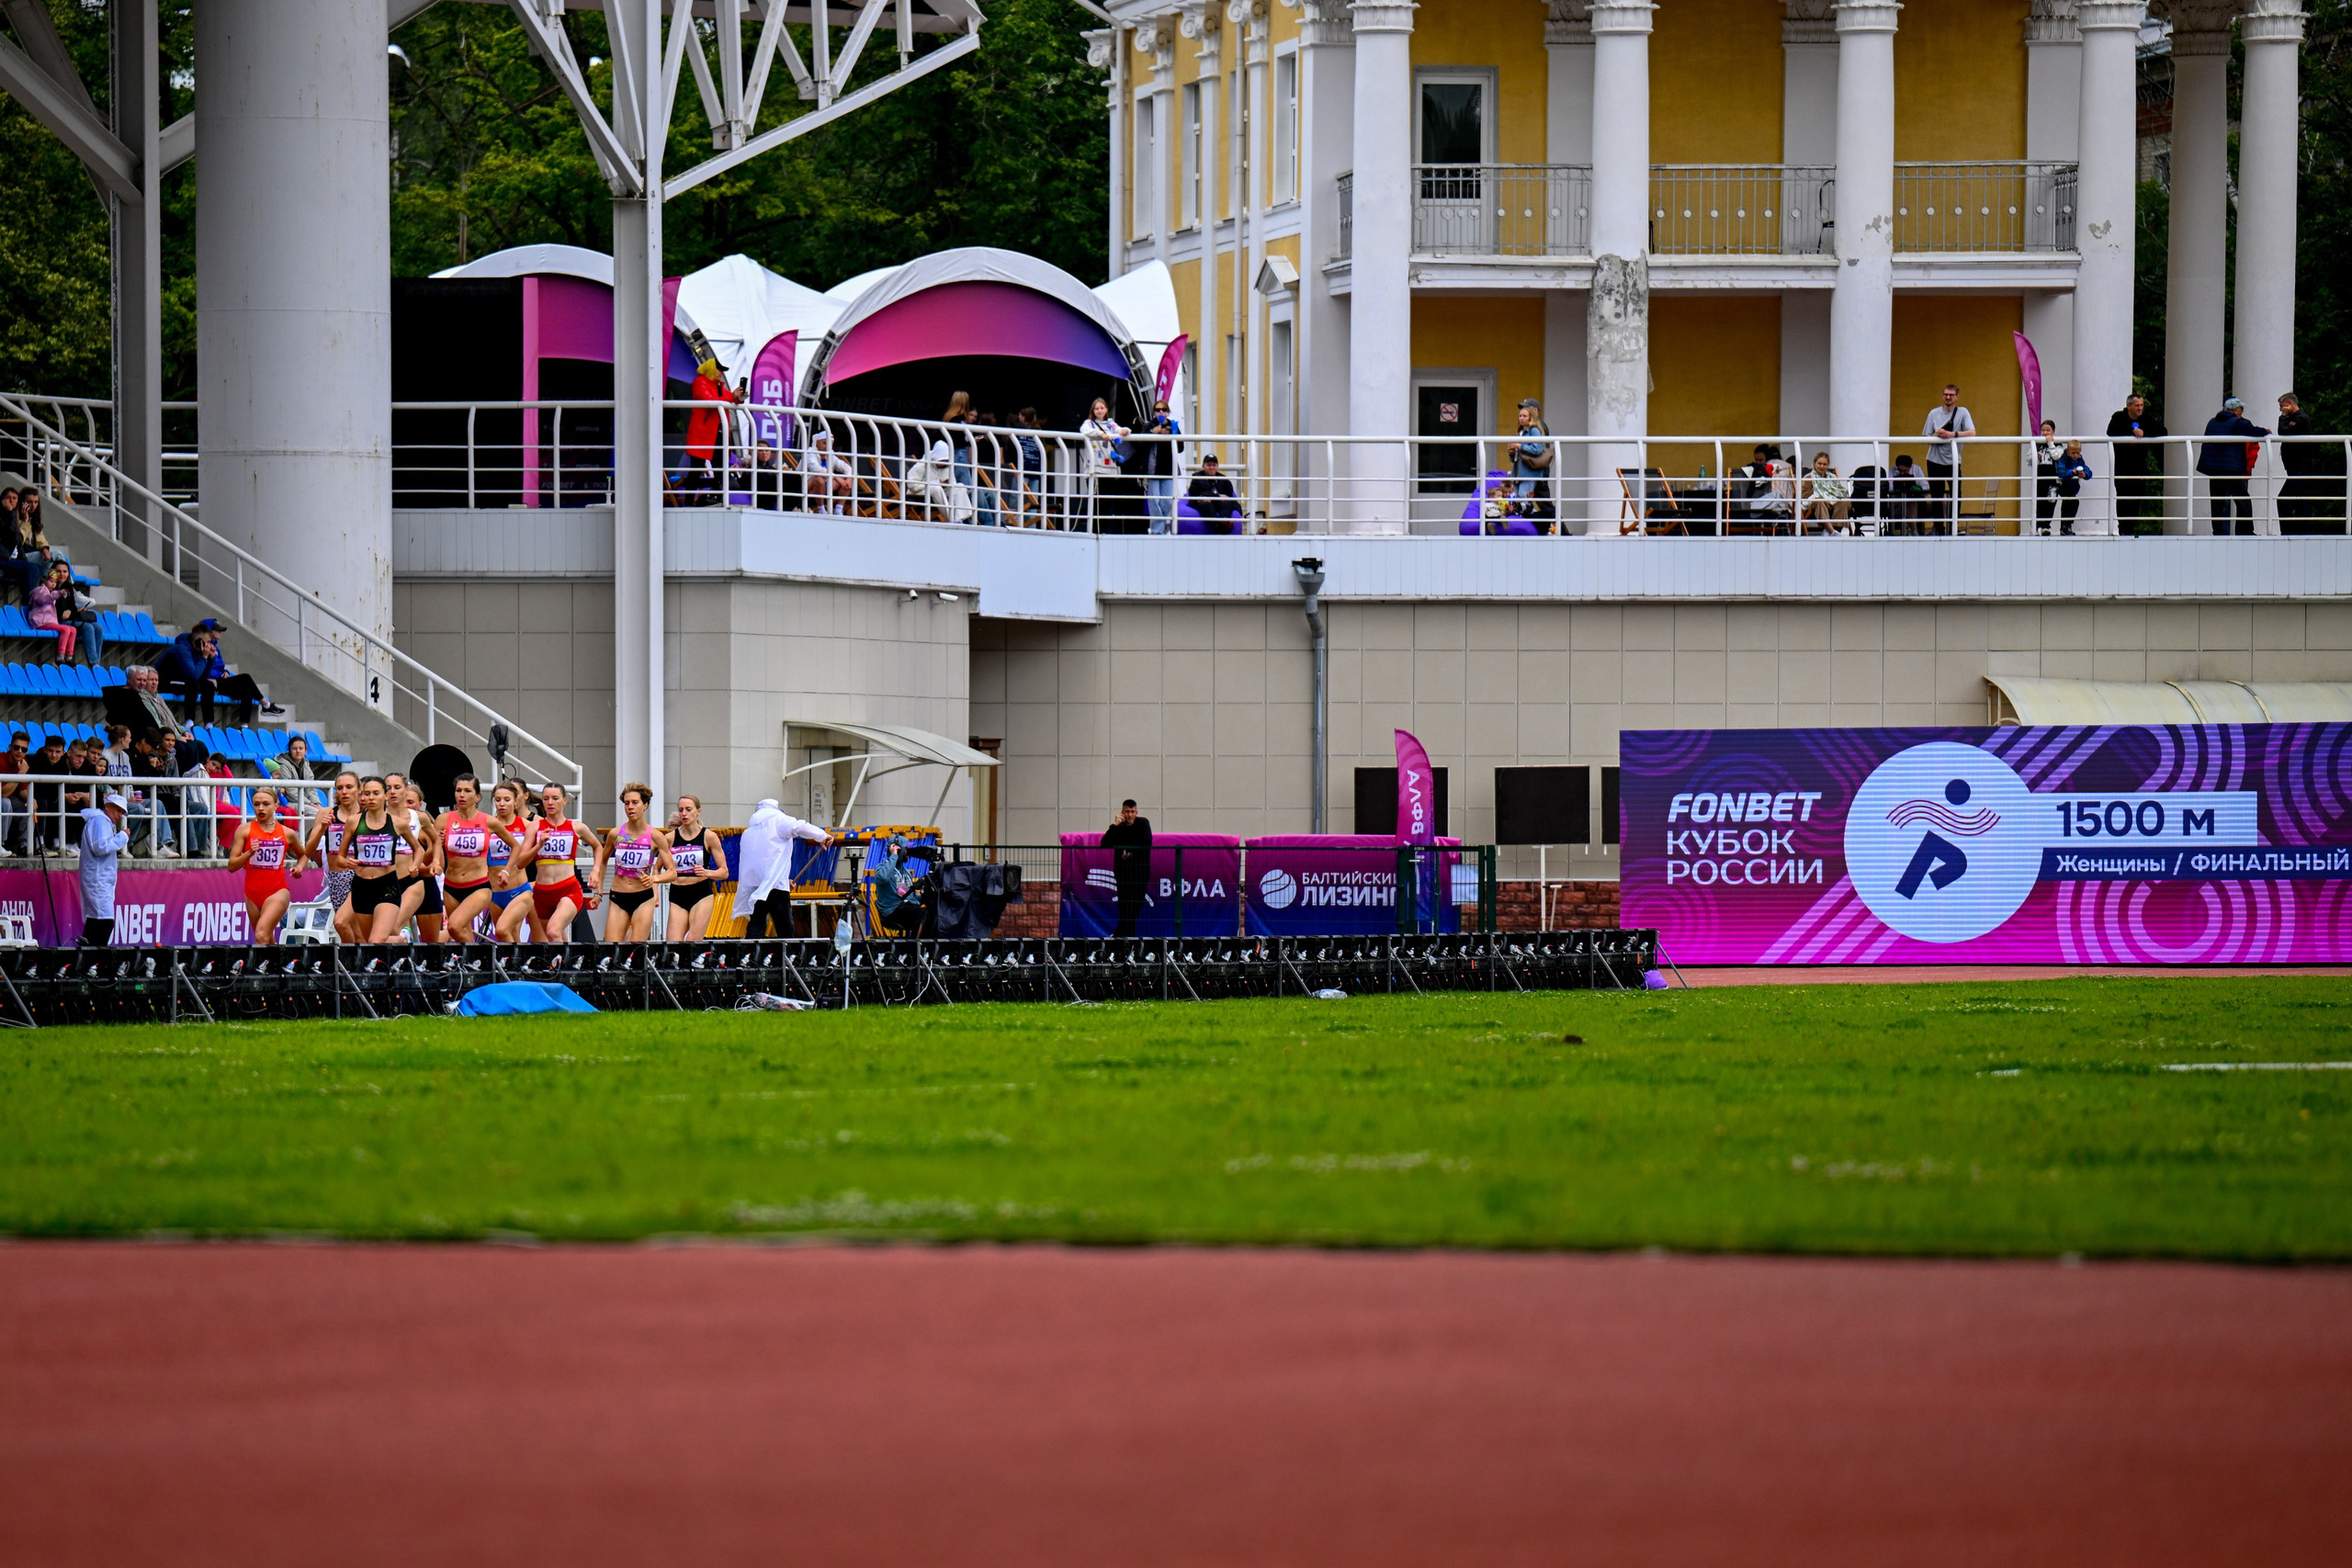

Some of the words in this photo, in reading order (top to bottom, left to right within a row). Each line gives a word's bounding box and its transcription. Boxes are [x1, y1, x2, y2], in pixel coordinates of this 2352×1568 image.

[761, 379, 783, 439] ПСБ
[1668, 792, 1822, 823] FONBET
[2056, 800, 2165, 837] 1500
[2182, 808, 2215, 836] м
[364, 844, 386, 859] 676
[455, 835, 477, 850] 459
[496, 840, 511, 853] 24
[544, 839, 566, 852] 538
[1667, 829, 1795, 855] КУБОК
[256, 848, 278, 863] 303
[620, 851, 643, 865] 497
[675, 853, 696, 867] 243
[2056, 854, 2165, 875] Женщины
[2190, 848, 2349, 872] ФИНАЛЬНЫЙ
[1302, 871, 1396, 885] БАЛТИЙСКИ
[1667, 859, 1823, 885] РОССИИ
[1159, 877, 1226, 897] ВФЛА
[0, 900, 35, 921] АНДА
[108, 903, 165, 944] NBET
[183, 902, 250, 942] FONBET
